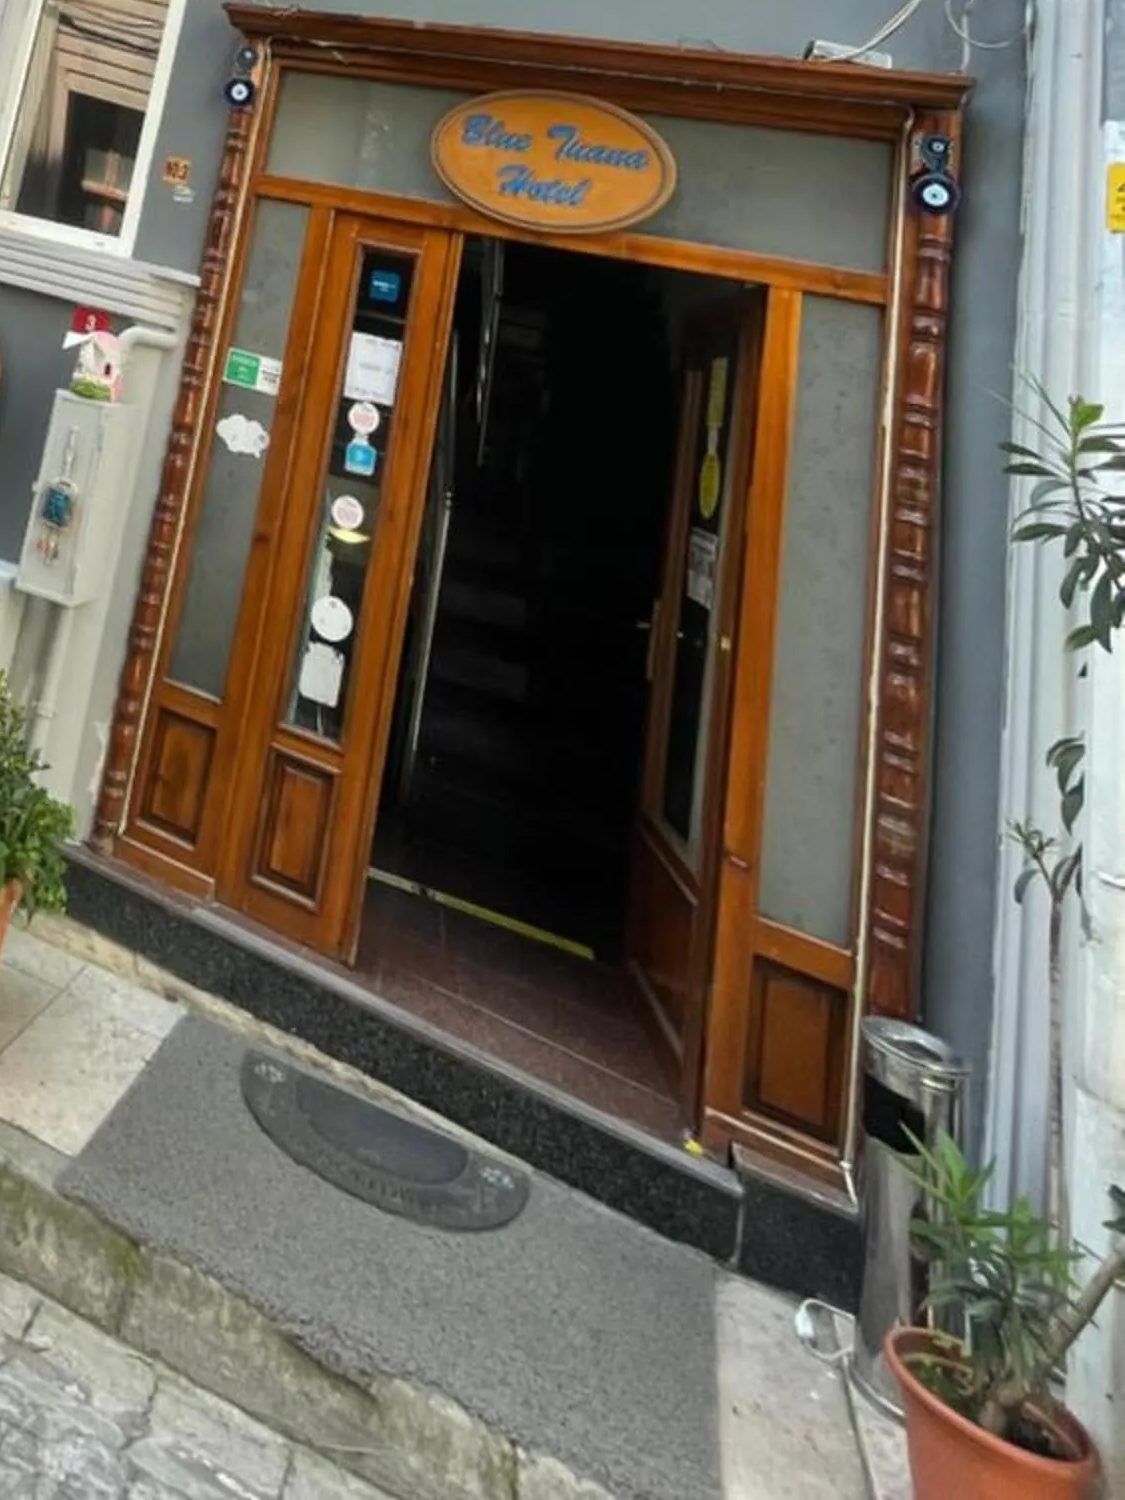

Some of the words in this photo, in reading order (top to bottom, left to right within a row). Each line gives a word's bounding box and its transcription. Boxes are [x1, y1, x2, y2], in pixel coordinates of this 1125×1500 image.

[462, 114, 533, 152] Blue
[547, 123, 649, 169] Tuana
[497, 164, 594, 206] Hotel
